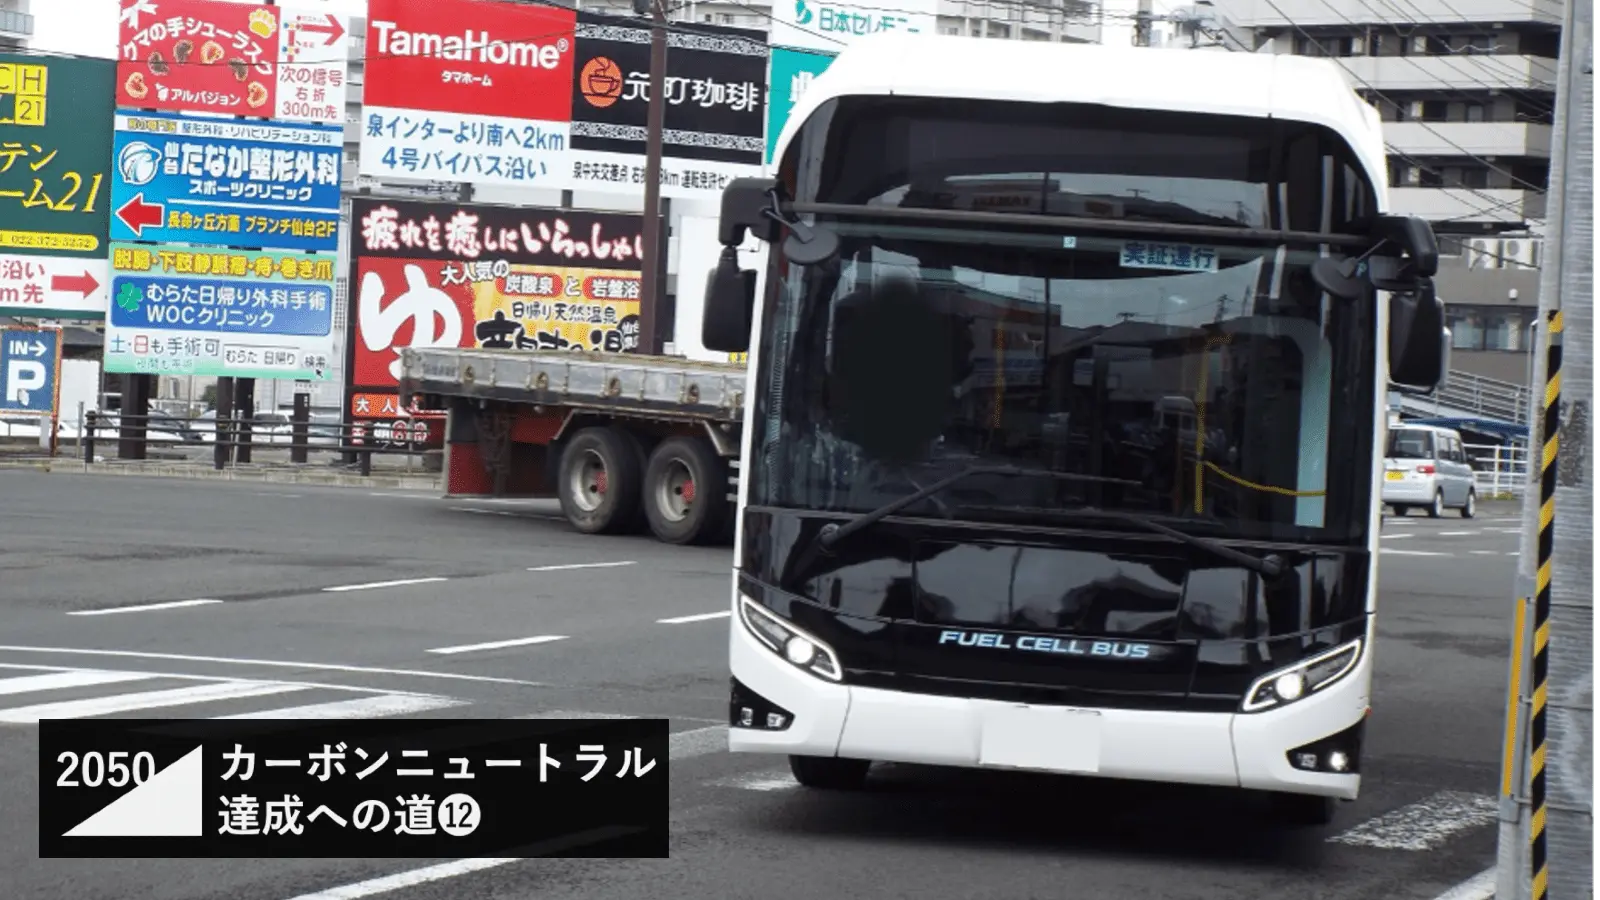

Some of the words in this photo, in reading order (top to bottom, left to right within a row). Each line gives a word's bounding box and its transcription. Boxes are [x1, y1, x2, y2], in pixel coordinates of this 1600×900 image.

[123, 16, 273, 75] クマの手シューラスク
[281, 66, 343, 87] 次の信号
[442, 69, 493, 87] タマホーム
[296, 88, 325, 102] 右折
[622, 71, 760, 112] 元町珈琲
[19, 100, 41, 120] 21
[283, 102, 338, 119] 300m先
[367, 113, 564, 151] 泉インターより南へ2km
[181, 144, 338, 186] たなか整形外科
[382, 146, 547, 180] 4号バイパス沿い
[190, 180, 312, 200] スポーツクリニック
[245, 216, 337, 237] ブランチ仙台2F
[1123, 241, 1216, 269] 実証運行
[440, 259, 511, 286] 大人気の
[147, 284, 327, 312] むらた日帰り外科手術
[505, 276, 553, 294] 炭酸泉
[565, 276, 582, 297] と
[592, 279, 640, 299] 岩盤浴
[147, 306, 275, 328] WOCクリニック
[512, 301, 619, 324] 日帰り天然温泉
[9, 340, 29, 356] IN
[226, 350, 258, 365] むらた
[6, 360, 46, 401] P
[939, 631, 1011, 649] FUEL
[1016, 636, 1084, 655] CELL
[1091, 642, 1150, 659] BUS
